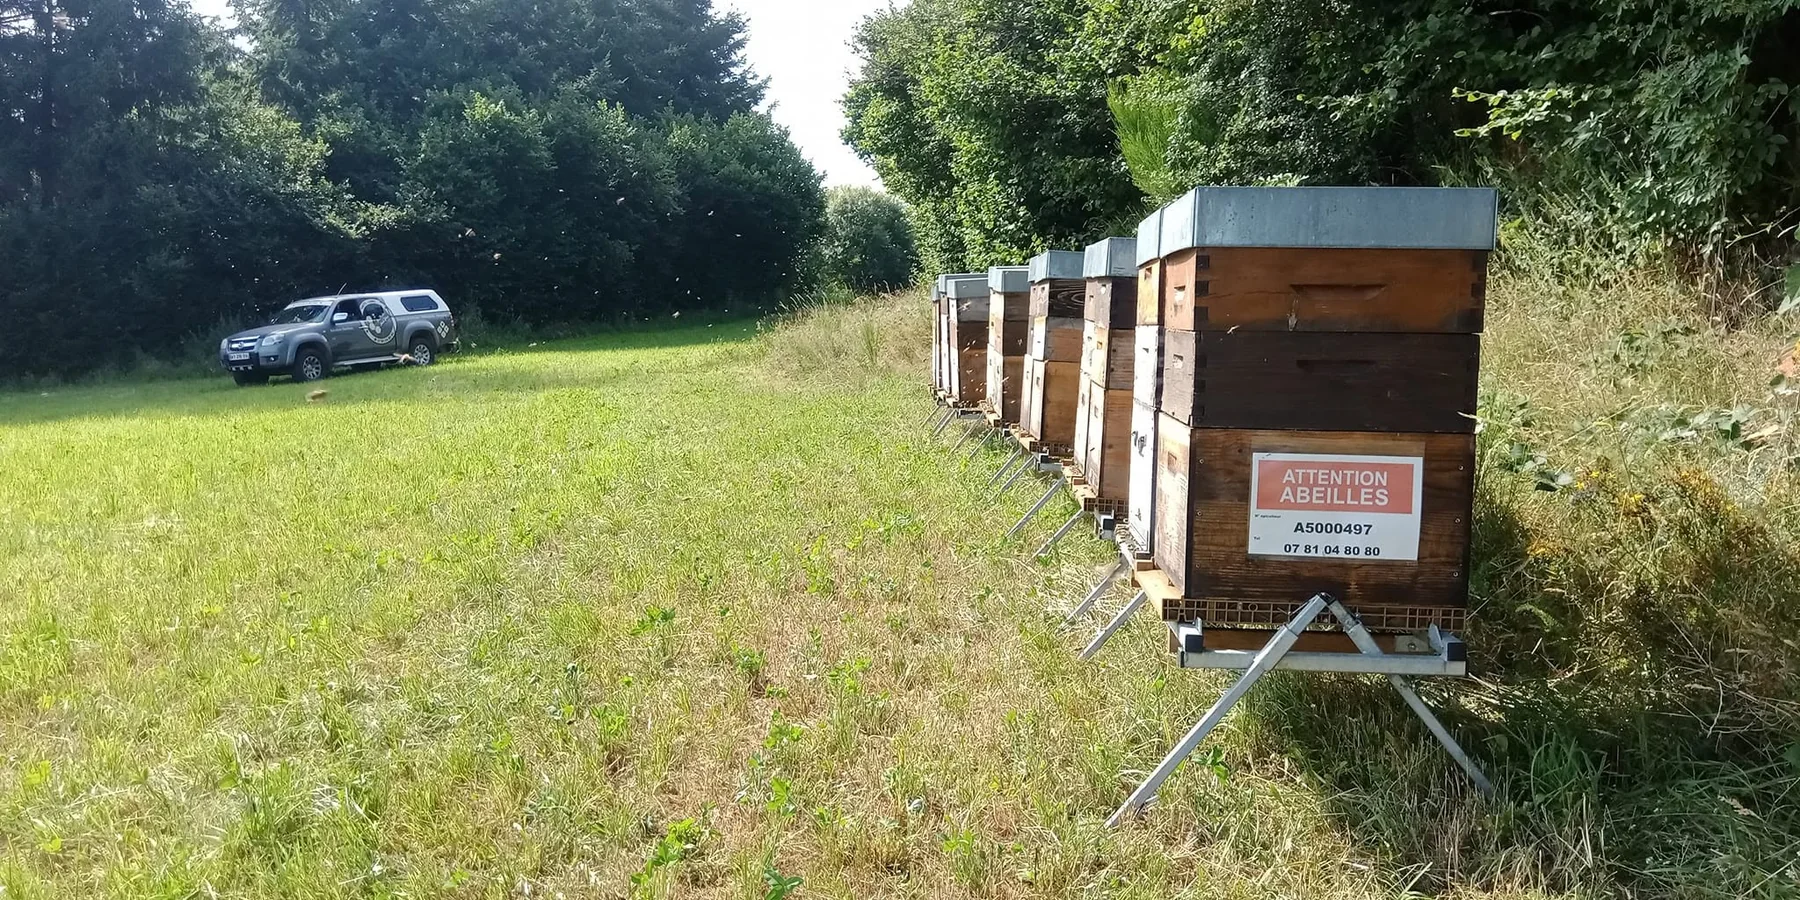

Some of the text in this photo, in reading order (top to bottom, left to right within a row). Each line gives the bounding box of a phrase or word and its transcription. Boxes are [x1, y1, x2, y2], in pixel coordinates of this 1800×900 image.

[1282, 468, 1388, 487] ATTENTION
[1279, 486, 1389, 506] ABEILLES
[1293, 522, 1373, 535] A5000497
[1283, 543, 1380, 556] 07 81 04 80 80
